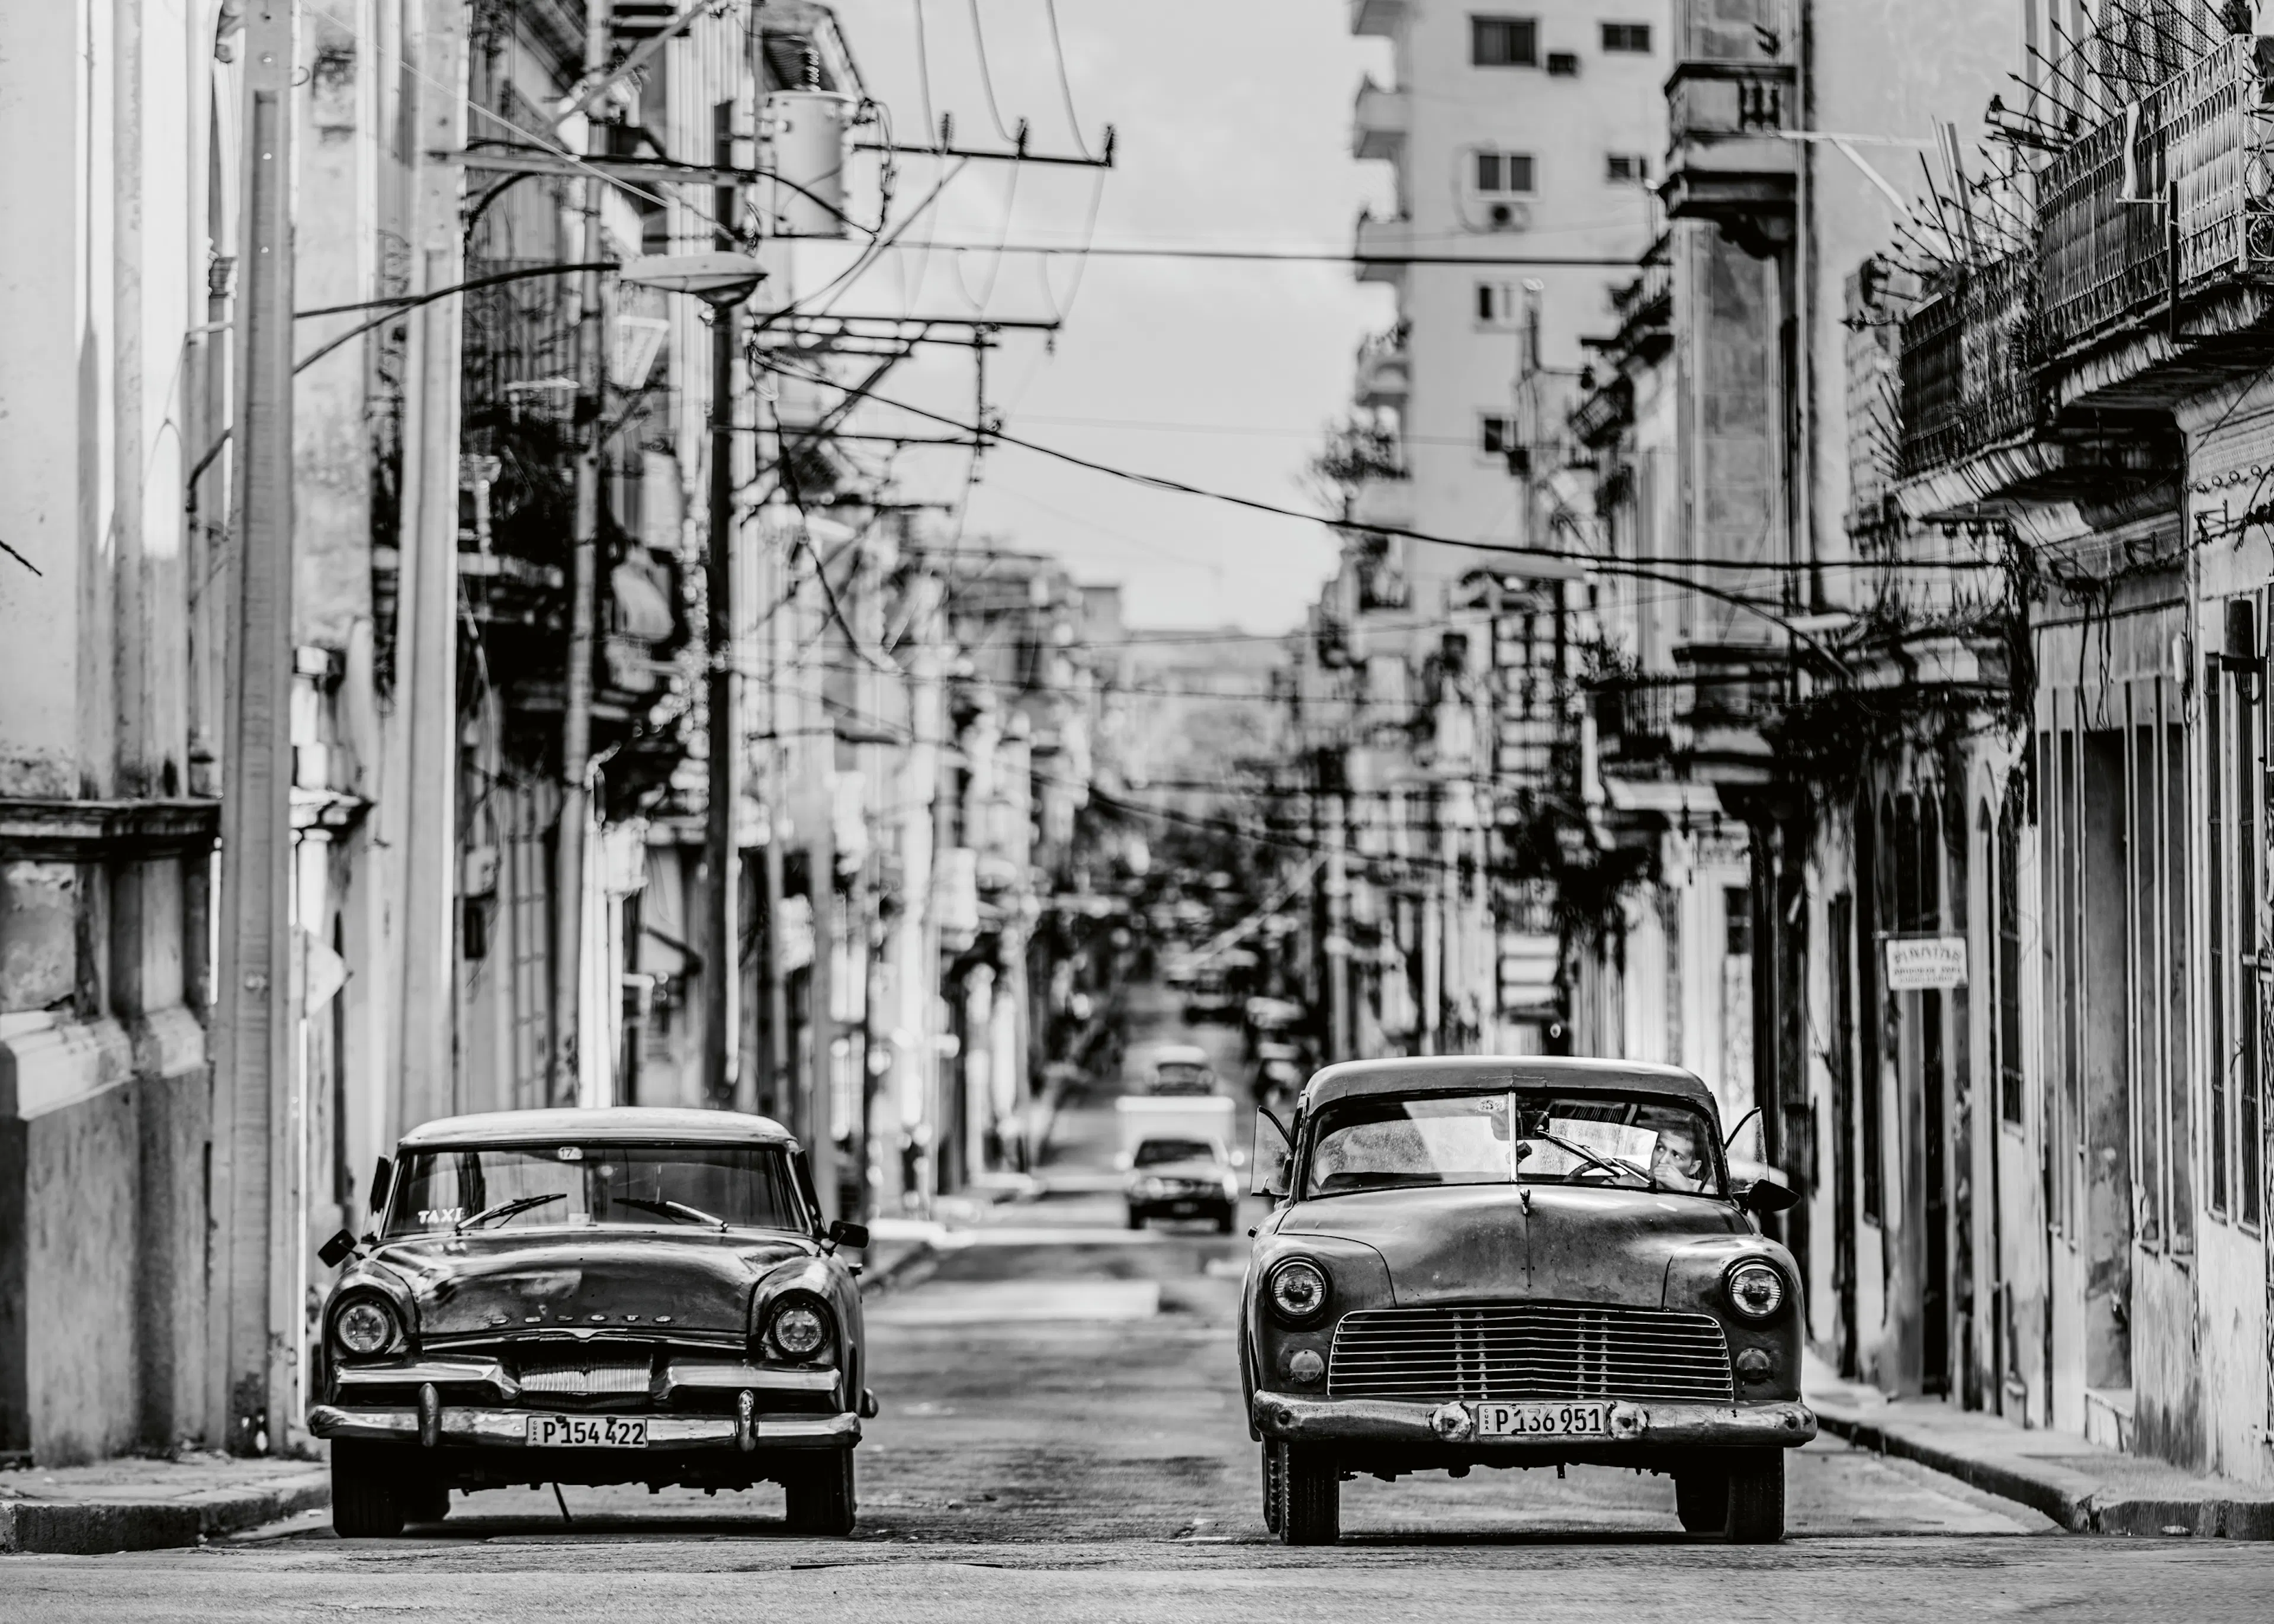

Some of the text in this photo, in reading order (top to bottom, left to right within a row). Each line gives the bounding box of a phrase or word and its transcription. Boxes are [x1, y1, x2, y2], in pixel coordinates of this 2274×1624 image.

[417, 1207, 463, 1224] TAXI
[1560, 1408, 1601, 1432] 951
[605, 1423, 644, 1445] 422
